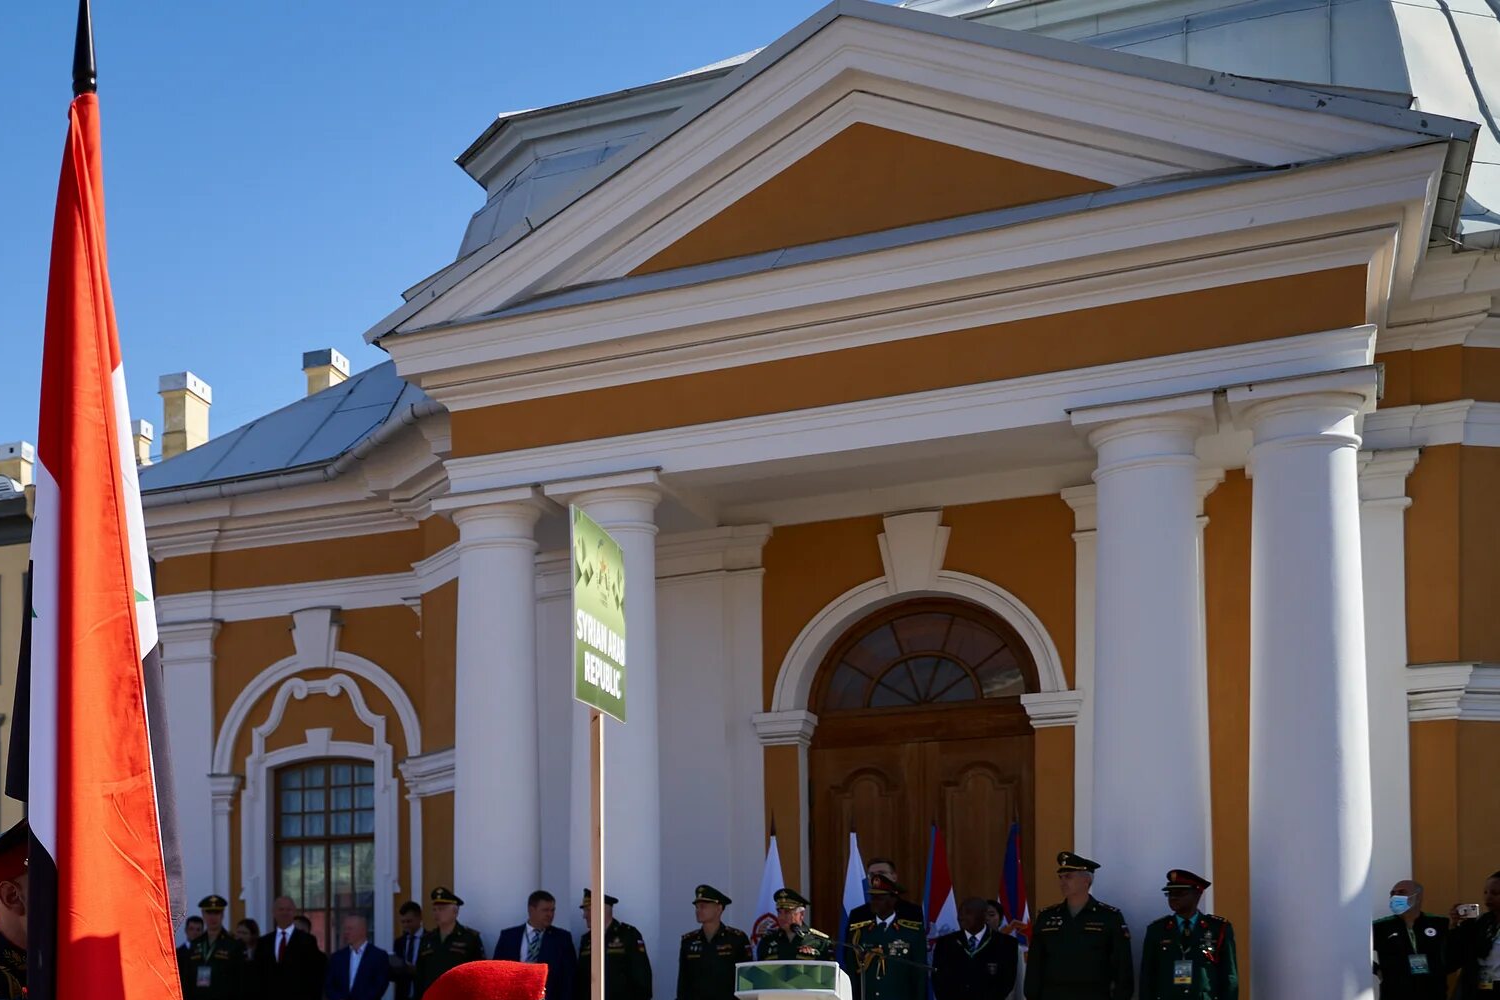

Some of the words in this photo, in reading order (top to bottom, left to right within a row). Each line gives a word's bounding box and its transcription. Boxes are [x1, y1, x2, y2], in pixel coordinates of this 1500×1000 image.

[576, 608, 607, 654] SYRIAN
[607, 630, 626, 666] ARAB
[584, 651, 622, 700] REPUBLIC
